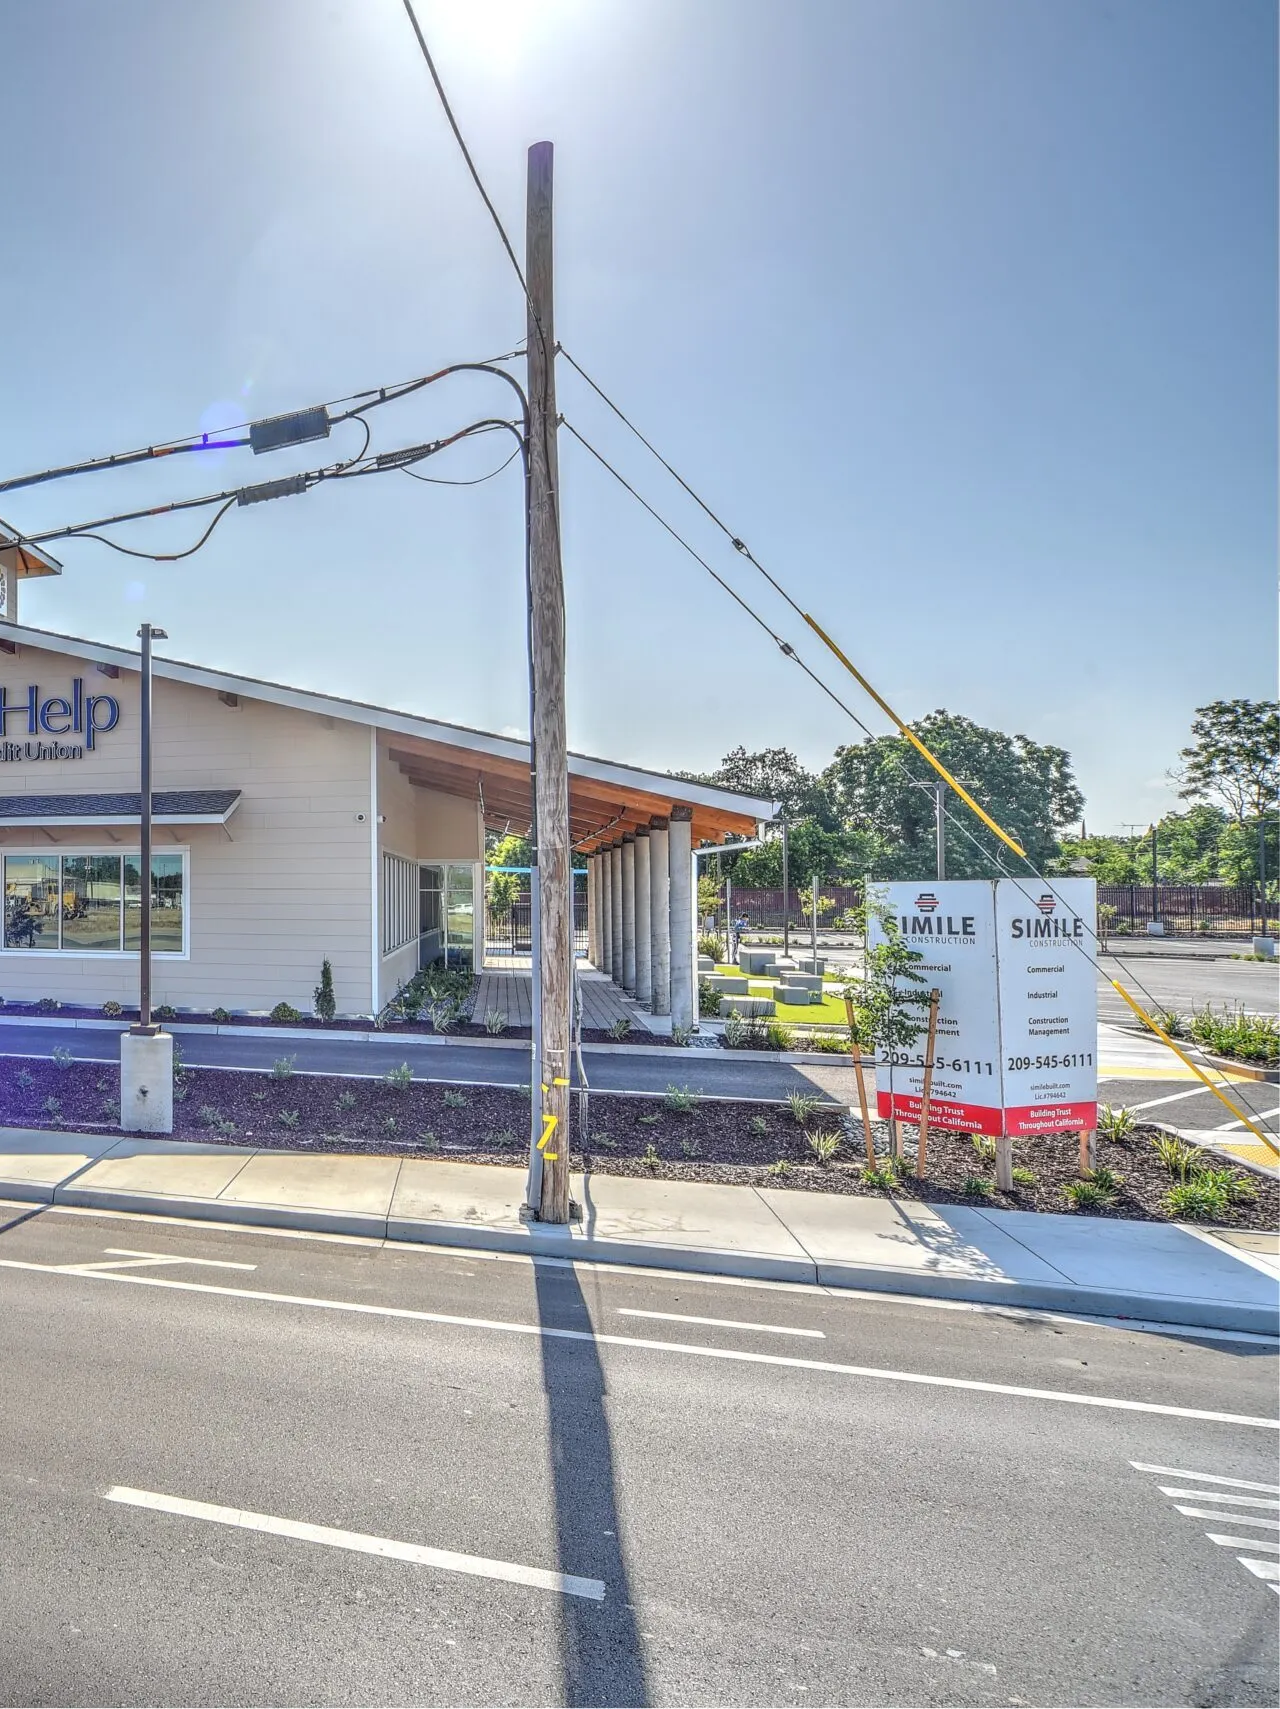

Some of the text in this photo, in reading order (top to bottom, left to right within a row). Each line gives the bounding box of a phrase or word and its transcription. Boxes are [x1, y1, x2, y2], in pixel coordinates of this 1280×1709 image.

[22, 741, 83, 760] Union
[1011, 918, 1084, 939] SIMILE
[906, 936, 976, 945] CONSTRUCTION
[1029, 939, 1083, 948] CONSTRUCTION
[1027, 965, 1065, 974] Commercial
[1027, 990, 1058, 999] Industrial
[1028, 1016, 1069, 1025] Construction
[1029, 1028, 1070, 1037] Management
[881, 1051, 993, 1075] 209-55-6111
[1008, 1053, 1092, 1071] 209-545-6111
[1030, 1083, 1071, 1091] similebuilt.com
[909, 1101, 965, 1116] Buiing Trust
[1030, 1108, 1072, 1118] Building Trust
[895, 1109, 983, 1129] Througout California
[1019, 1118, 1084, 1130] Throughout California
